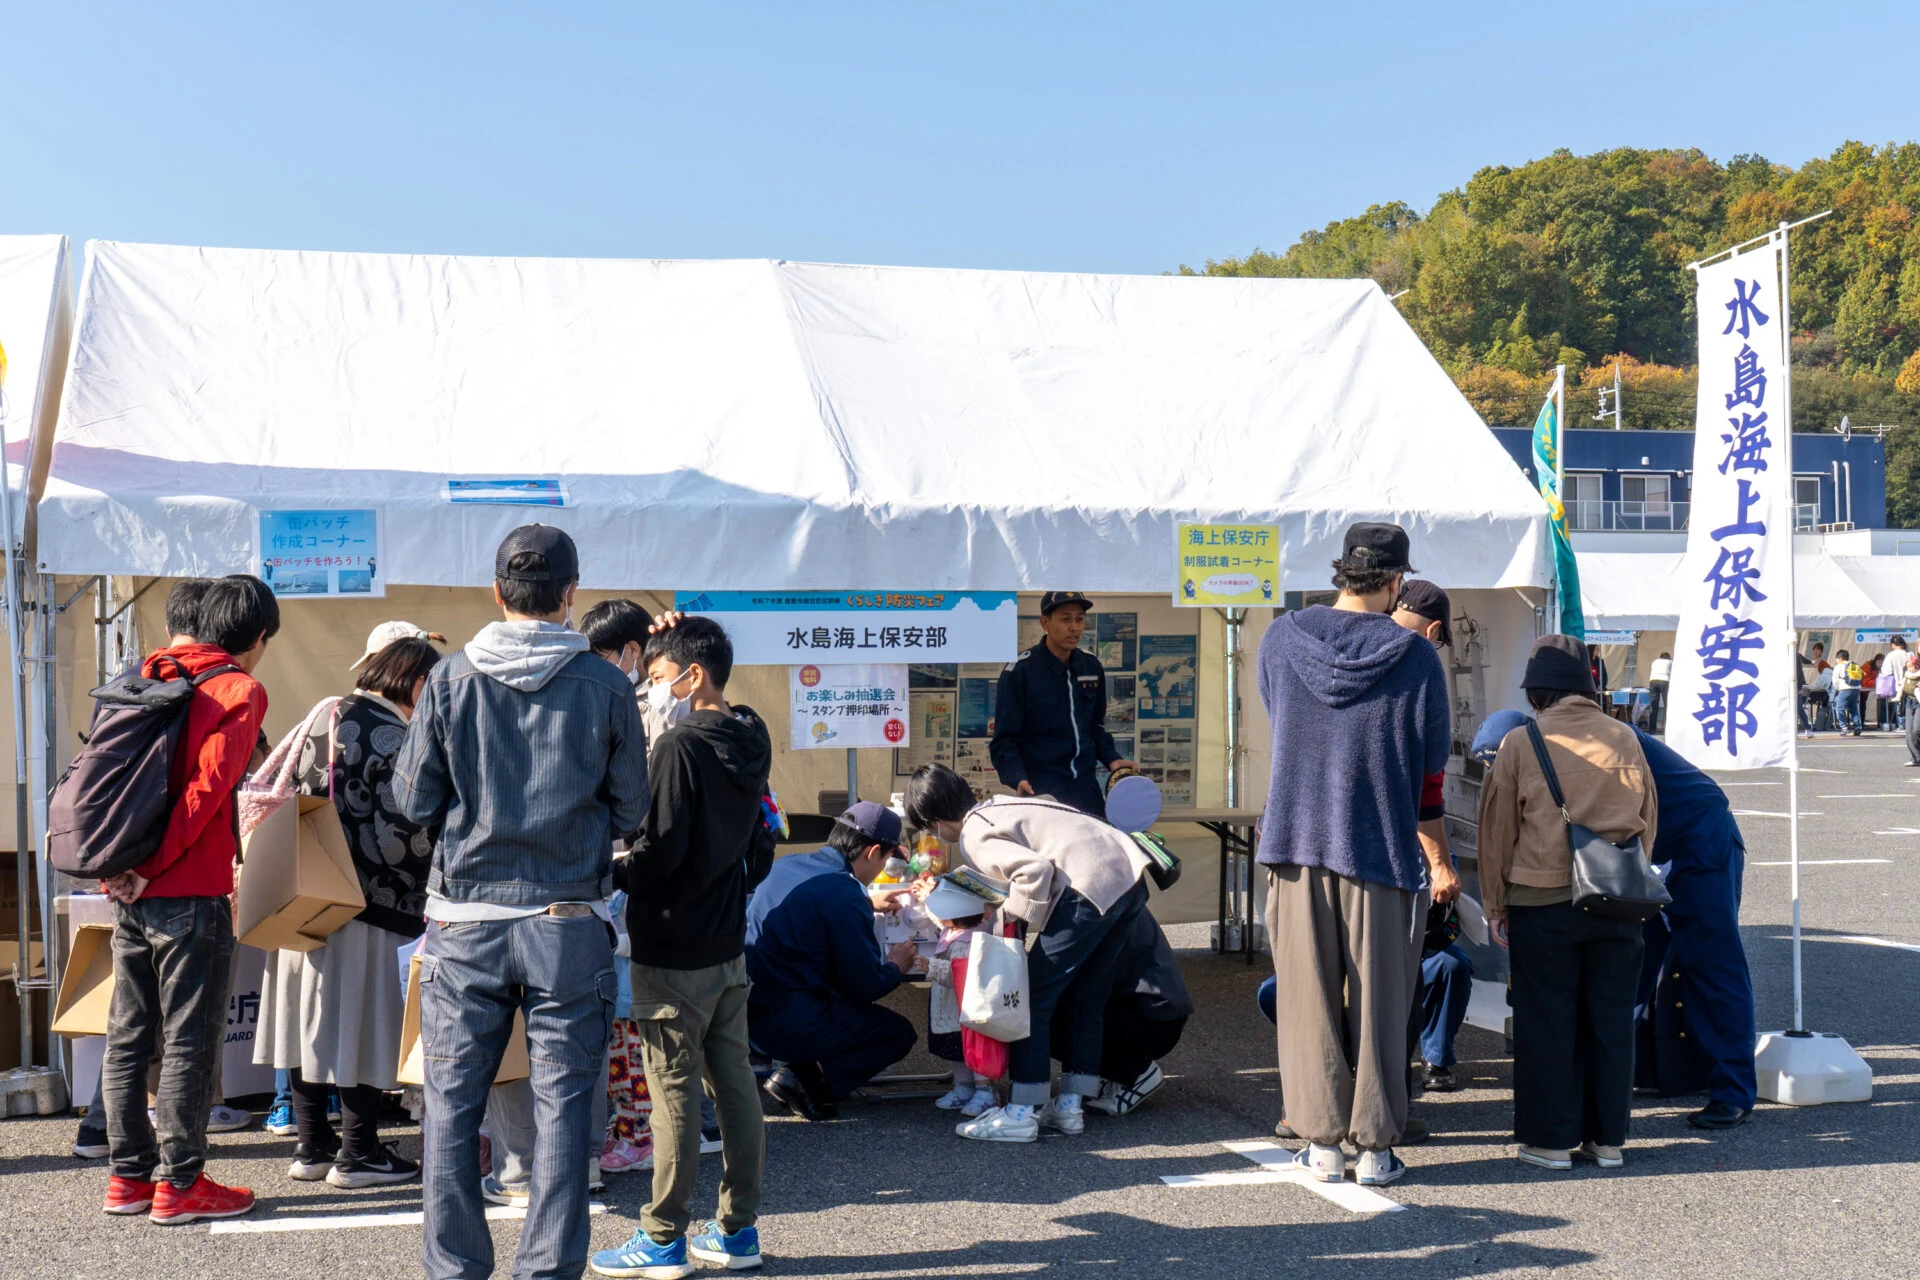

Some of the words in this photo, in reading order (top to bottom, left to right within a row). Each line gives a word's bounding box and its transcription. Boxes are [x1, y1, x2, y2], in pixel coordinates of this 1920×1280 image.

[287, 515, 350, 530] 缶バッチ
[1692, 278, 1772, 757] 水島海上保安部
[272, 533, 366, 549] 作成コーナー
[1188, 529, 1269, 546] 海上保安庁
[1184, 556, 1274, 568] 制服試着コーナー
[846, 593, 945, 609] くらしき防災フェア
[787, 627, 947, 649] 水島海上保安部
[806, 688, 896, 702] お楽しみ抽選会
[227, 991, 261, 1025] 庁
